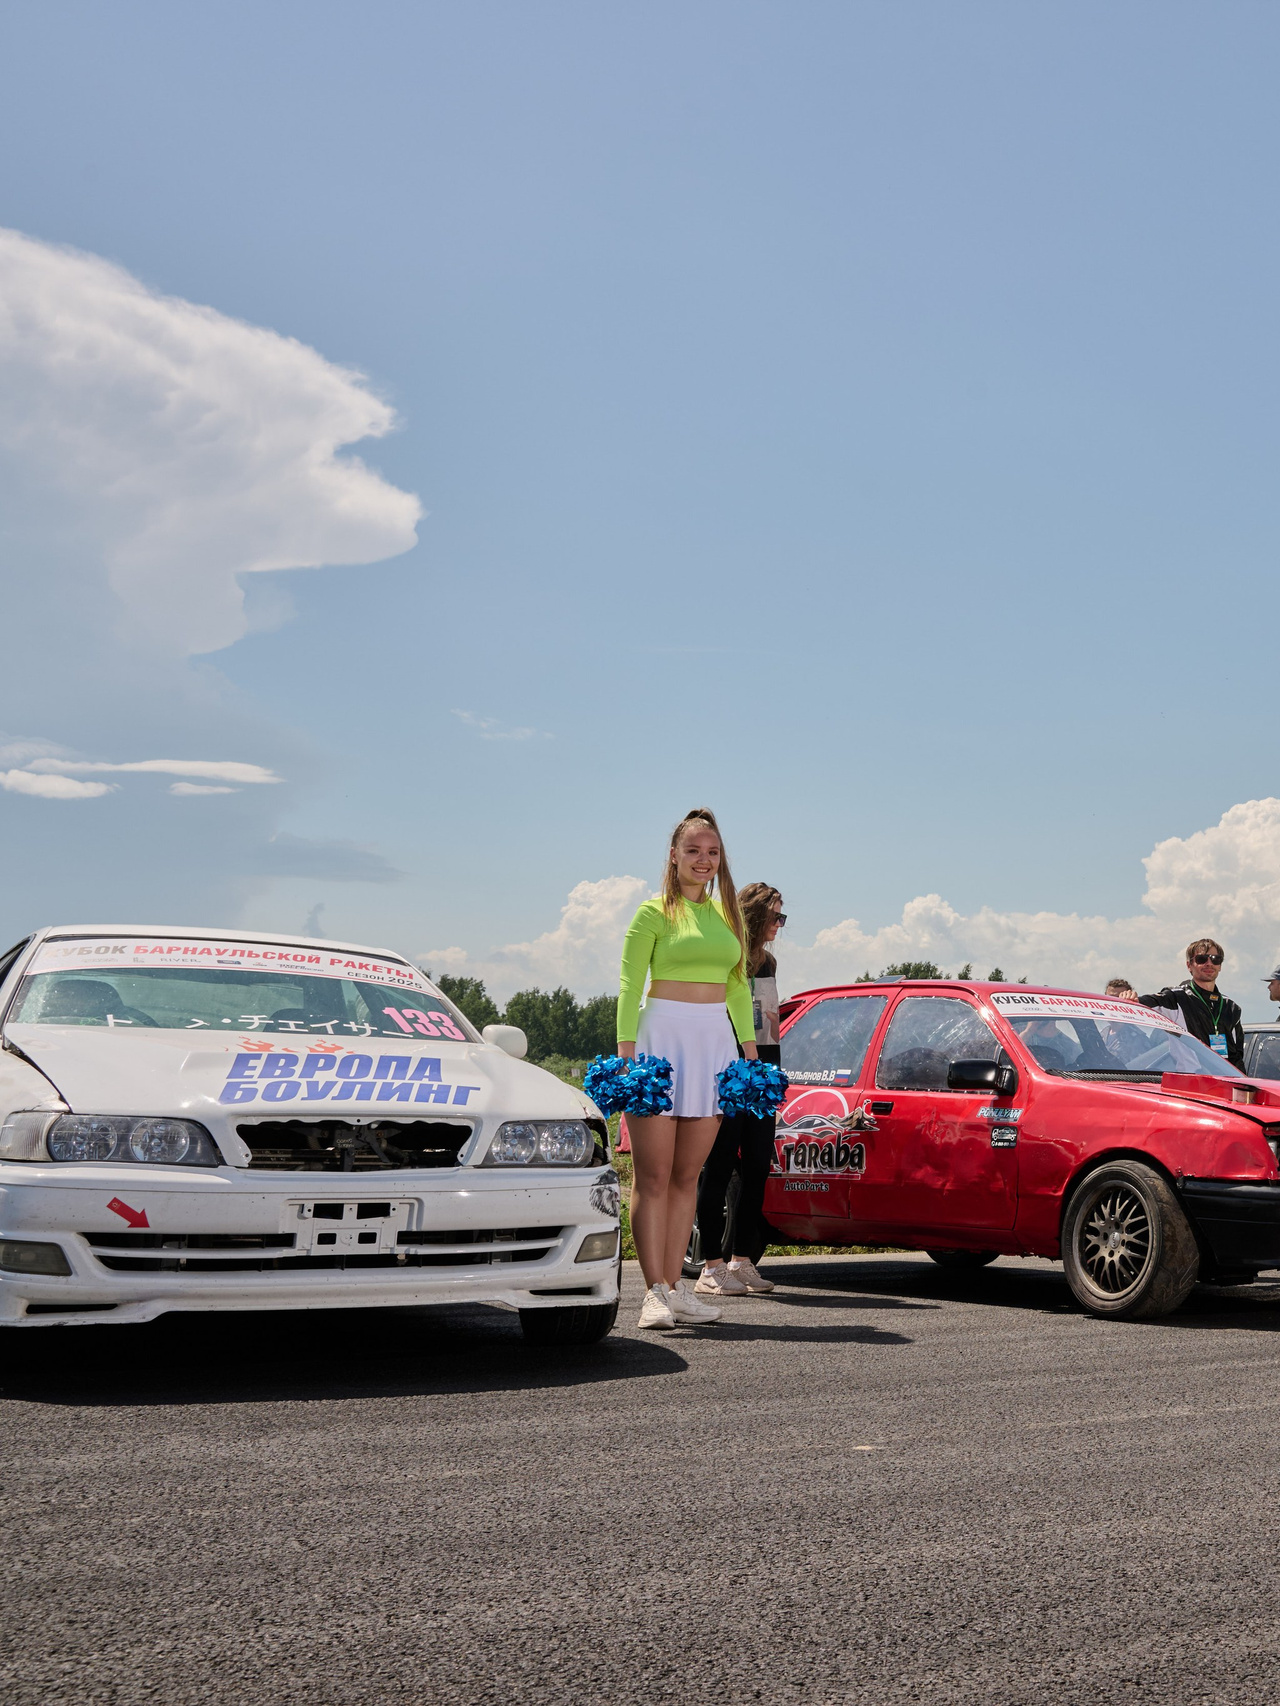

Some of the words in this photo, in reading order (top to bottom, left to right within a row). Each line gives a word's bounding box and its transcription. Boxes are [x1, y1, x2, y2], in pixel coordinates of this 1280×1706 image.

[133, 945, 321, 964] БАРНАУЛЬСКОЙ
[329, 958, 414, 979] РАКЕТЫ
[347, 971, 385, 981] СЕЗОН
[388, 976, 423, 989] 2025
[992, 995, 1039, 1004] КУБОК
[1039, 997, 1137, 1015] БАРНАУЛЬСКОЙ
[382, 1007, 466, 1041] 133
[226, 1053, 442, 1082] ЕВРОПА
[218, 1080, 481, 1106] БОУЛИНГ
[784, 1180, 829, 1192] AutoParts
